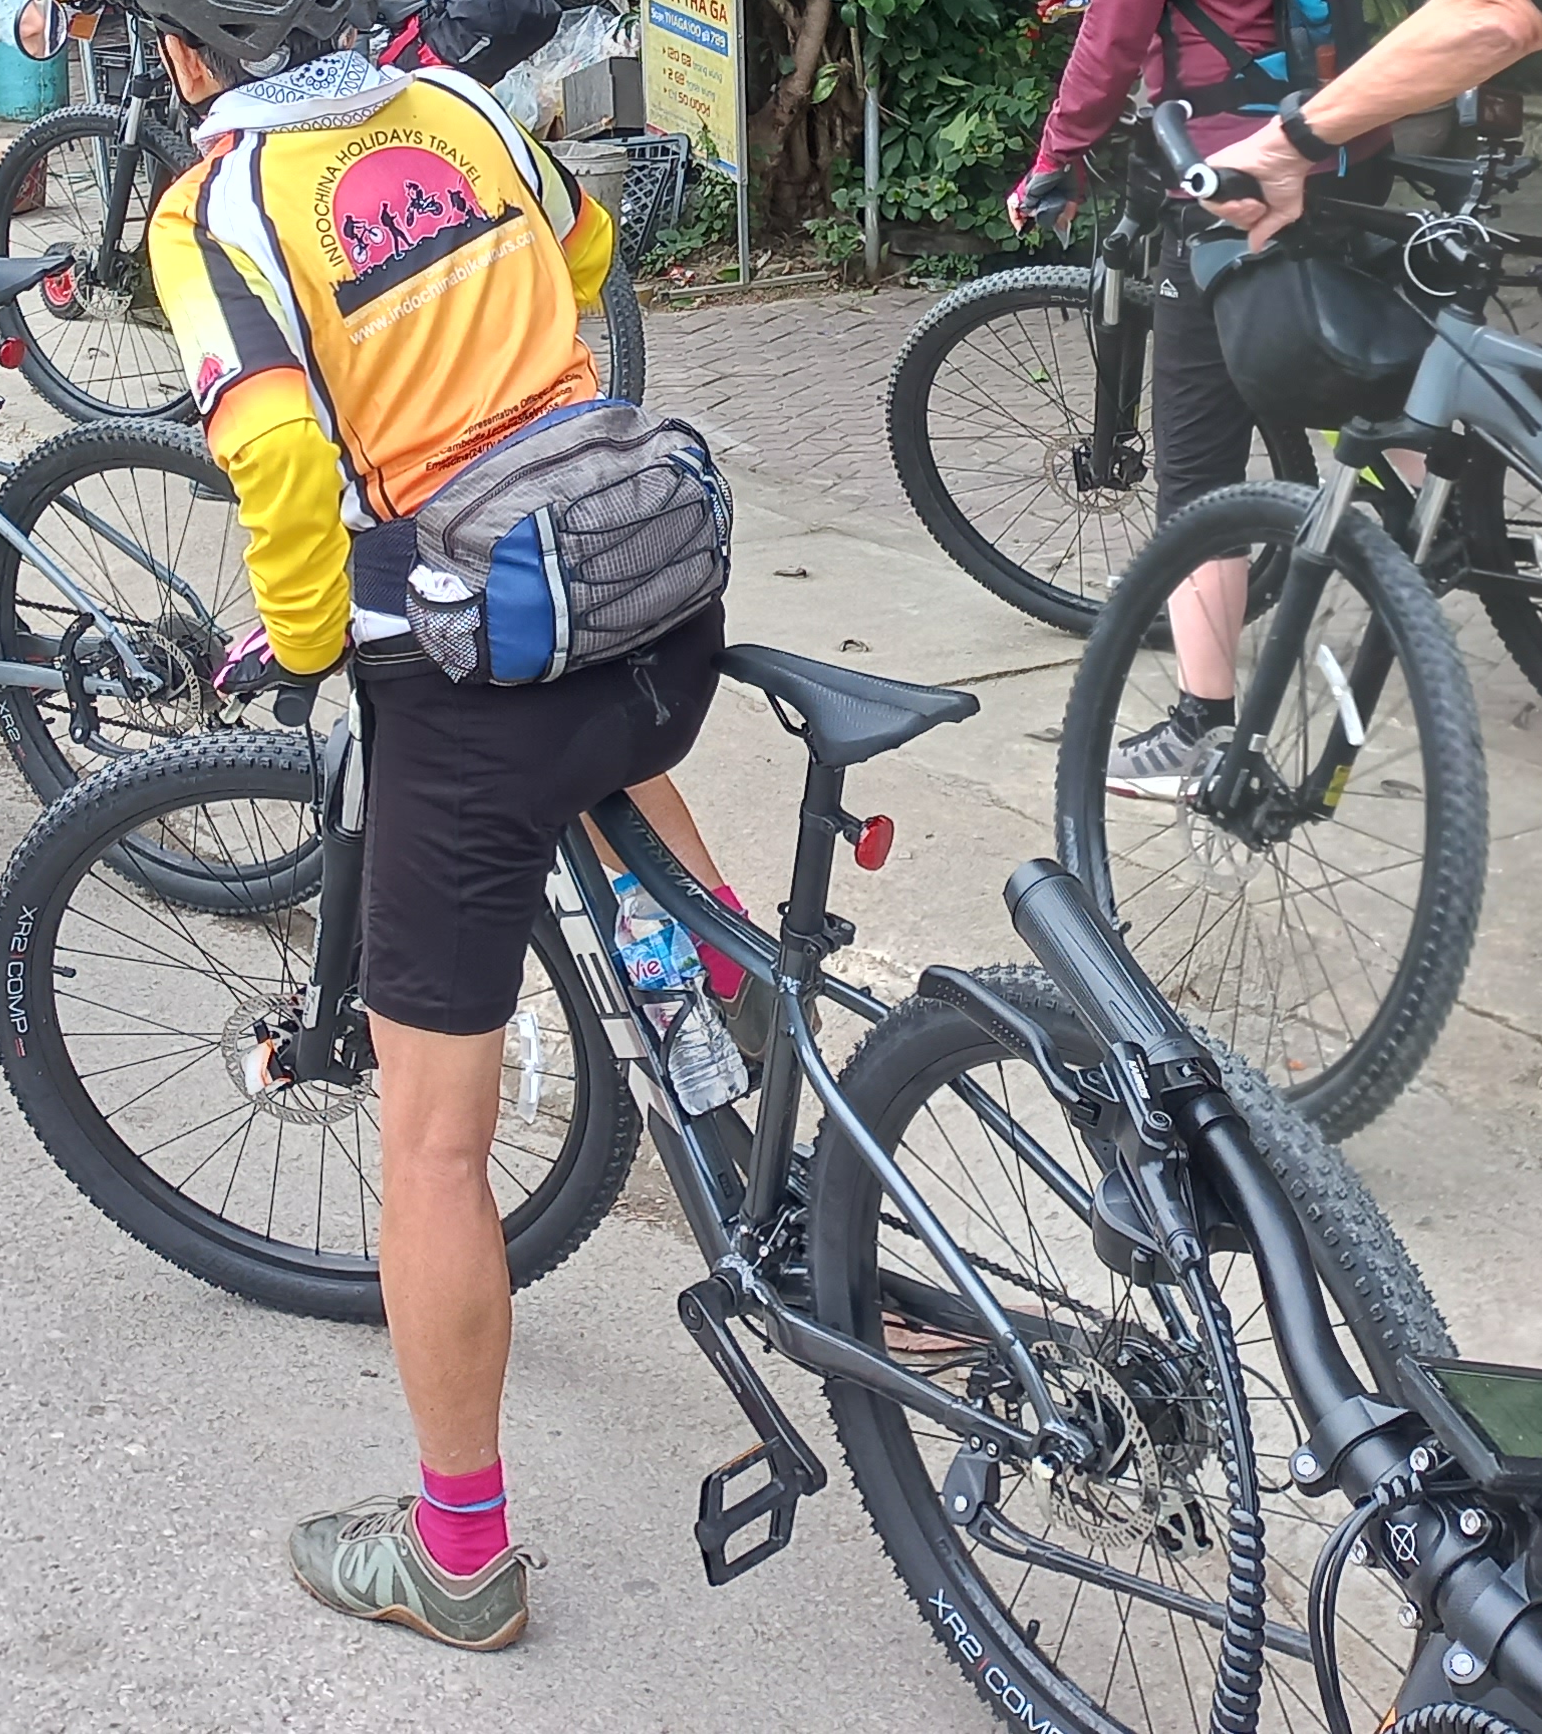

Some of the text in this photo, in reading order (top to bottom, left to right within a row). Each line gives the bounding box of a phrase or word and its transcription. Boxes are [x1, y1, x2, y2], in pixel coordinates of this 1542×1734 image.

[709, 0, 728, 25] GA
[314, 128, 482, 268] INDOCHINA HOLIDAYS TRAVEL
[10, 904, 39, 954] XR2
[7, 960, 30, 1035] COMP
[928, 1587, 984, 1665] XR2
